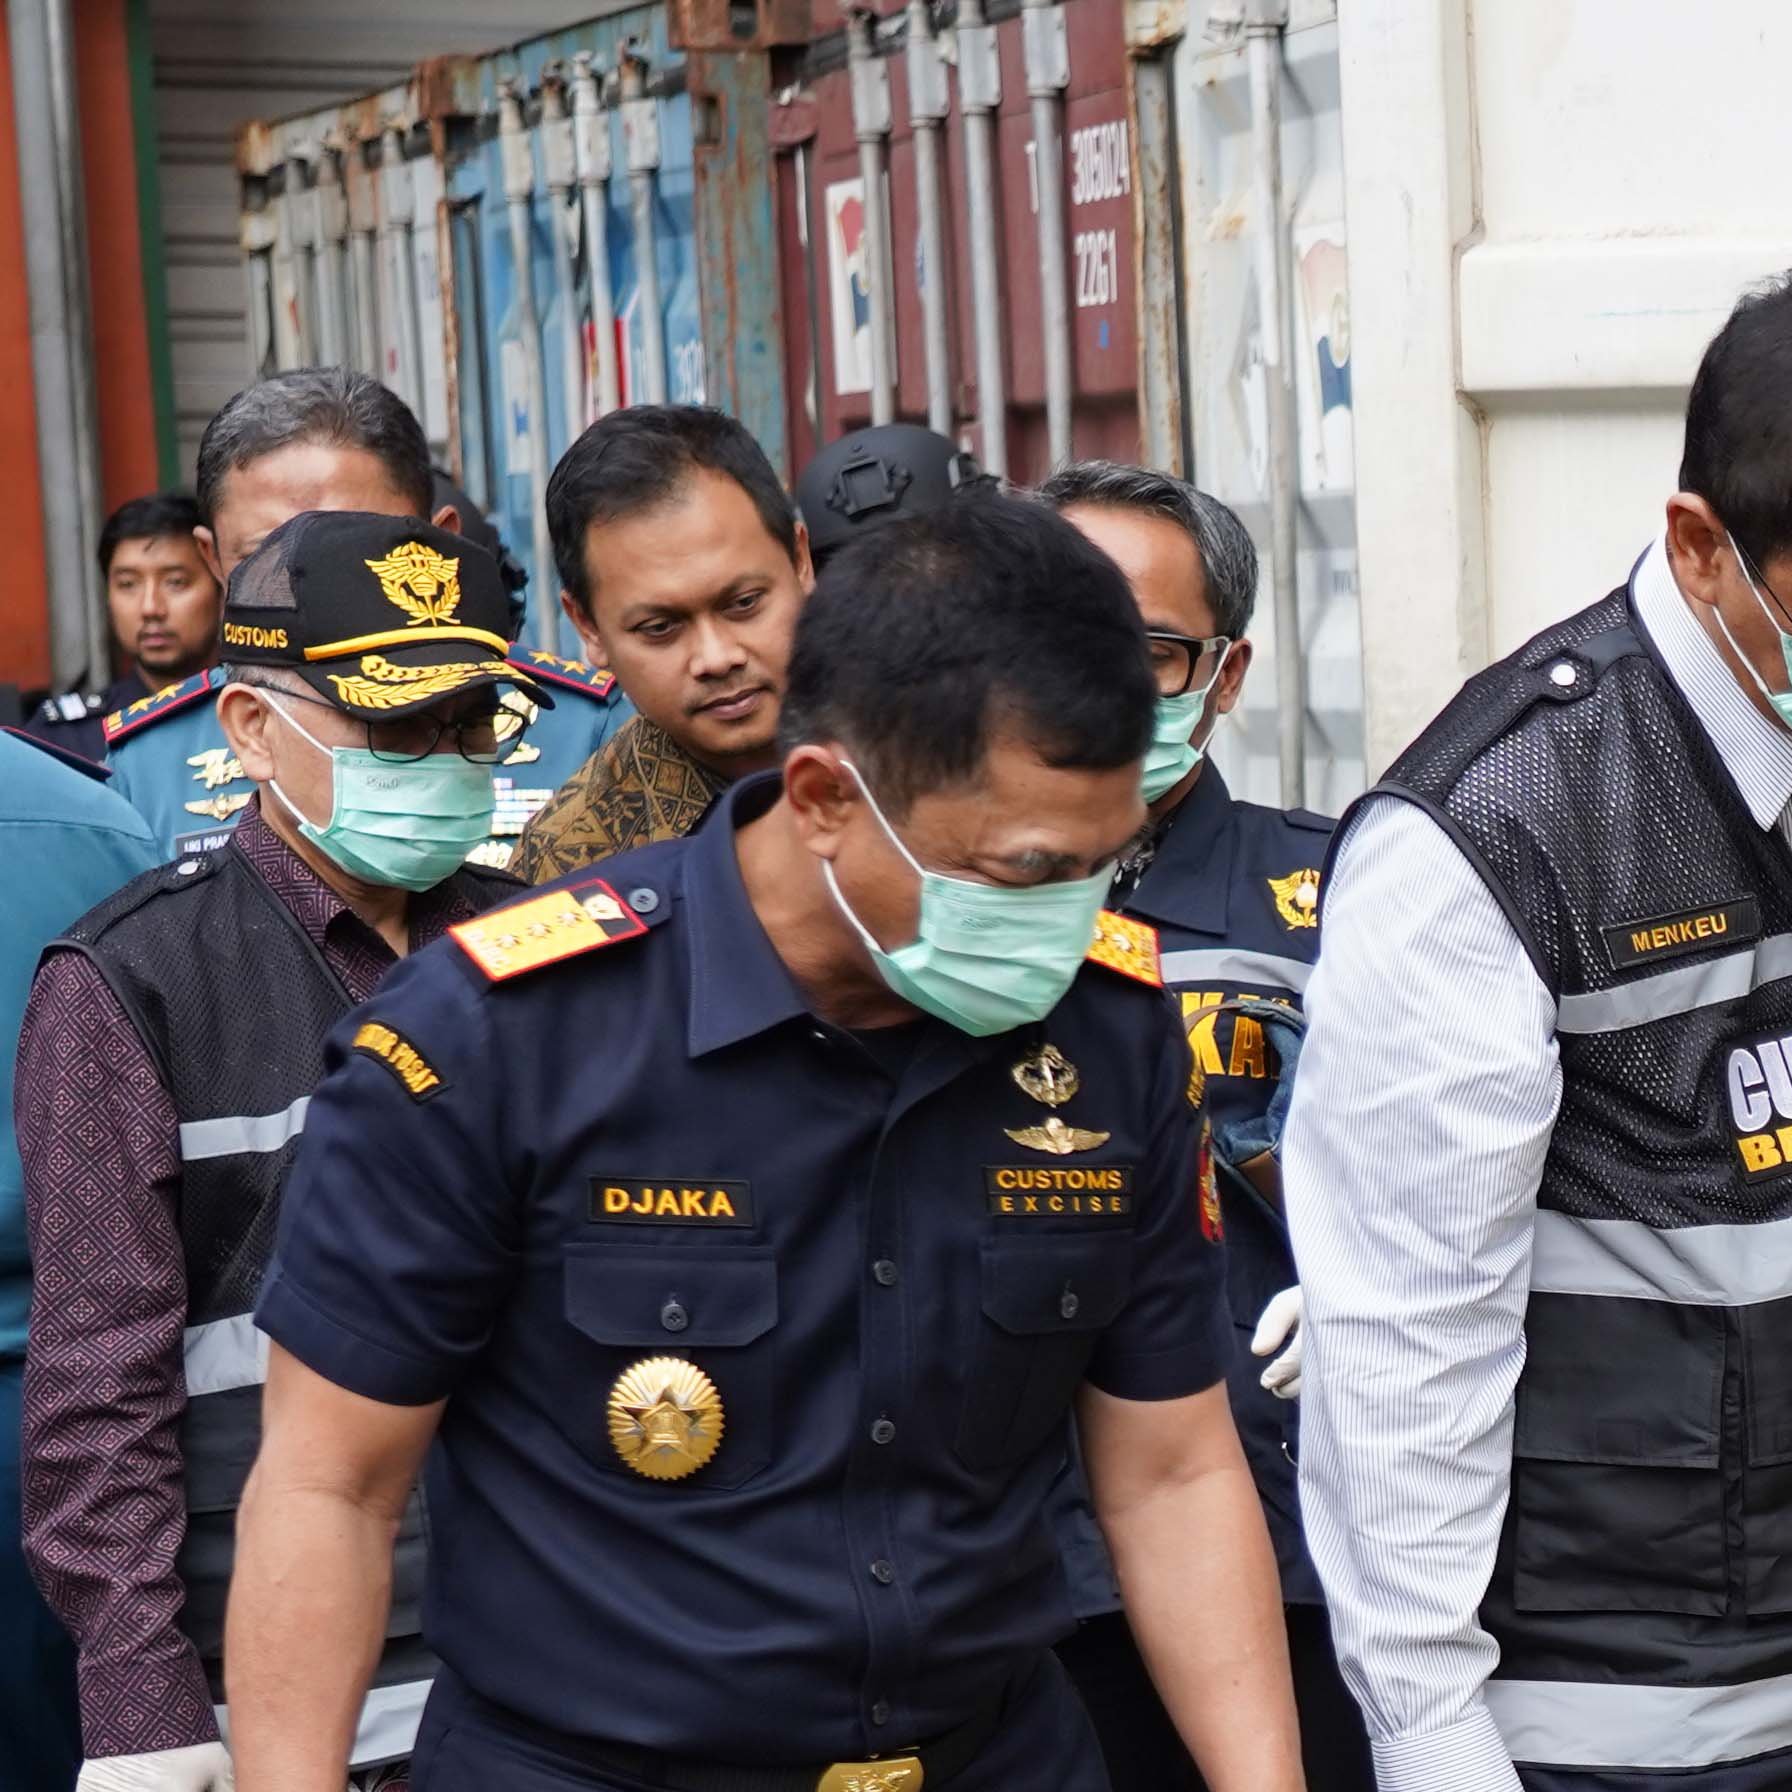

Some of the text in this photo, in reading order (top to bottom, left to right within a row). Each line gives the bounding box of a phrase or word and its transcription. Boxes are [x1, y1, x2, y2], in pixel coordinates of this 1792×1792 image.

[1073, 228, 1117, 308] 22G1
[224, 623, 288, 648] CUSTOMS
[1631, 913, 1727, 953] MENKEU
[997, 1169, 1123, 1190] CUSTOMS
[604, 1188, 736, 1217] DJAKA
[1000, 1195, 1122, 1213] EXCISE
